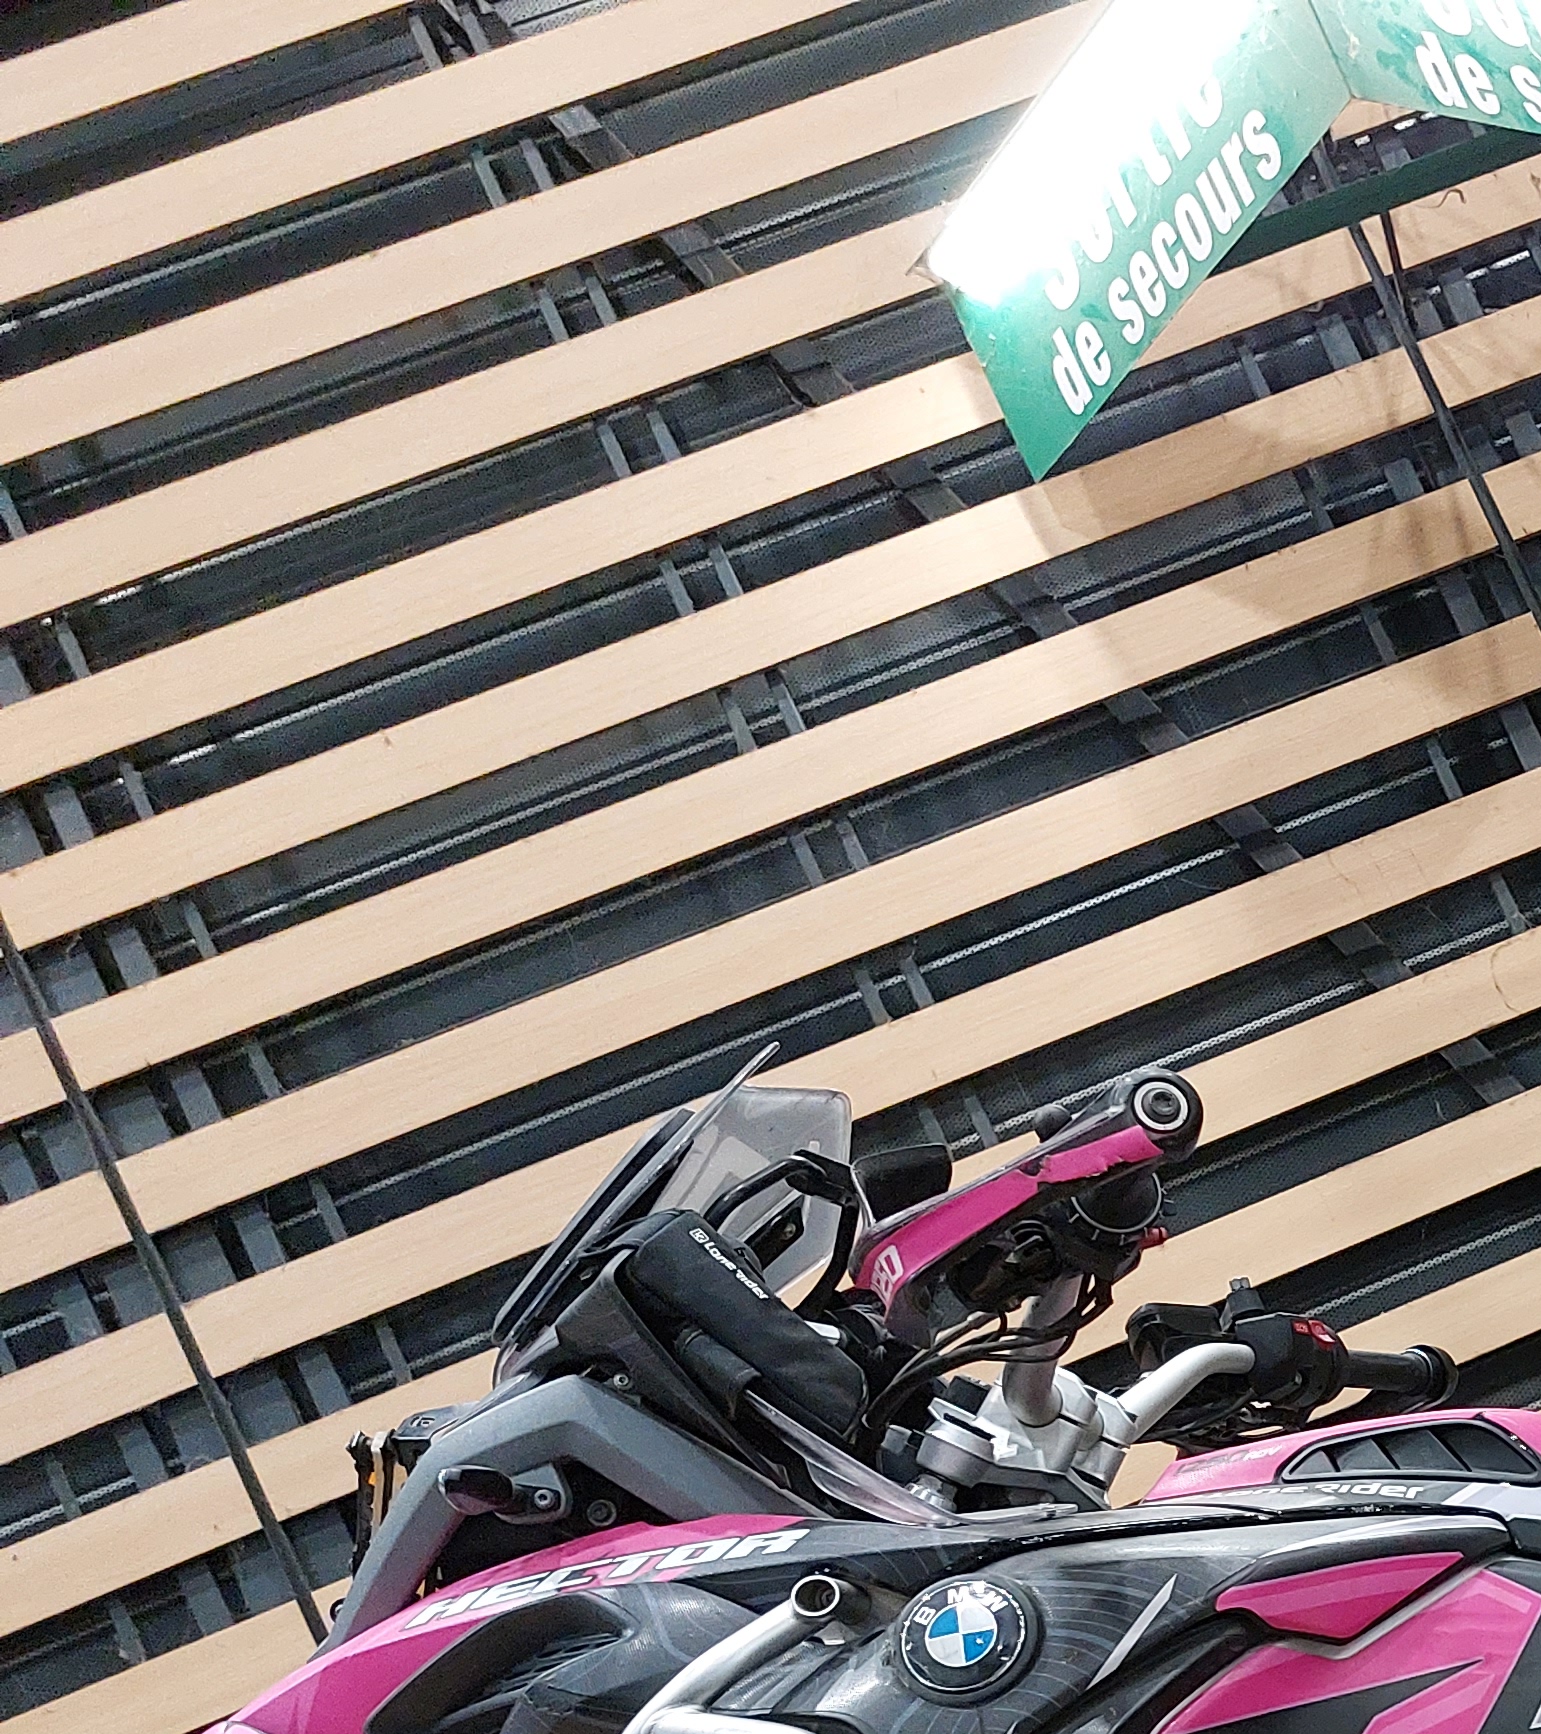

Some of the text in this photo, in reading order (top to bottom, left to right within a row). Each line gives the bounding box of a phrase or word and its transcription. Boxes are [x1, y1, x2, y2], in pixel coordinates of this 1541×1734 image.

[1415, 31, 1501, 116] de
[1052, 109, 1282, 415] de secours
[1314, 1482, 1425, 1500] Rider
[403, 1528, 811, 1630] HECTOR
[913, 1584, 1009, 1626] BMW
